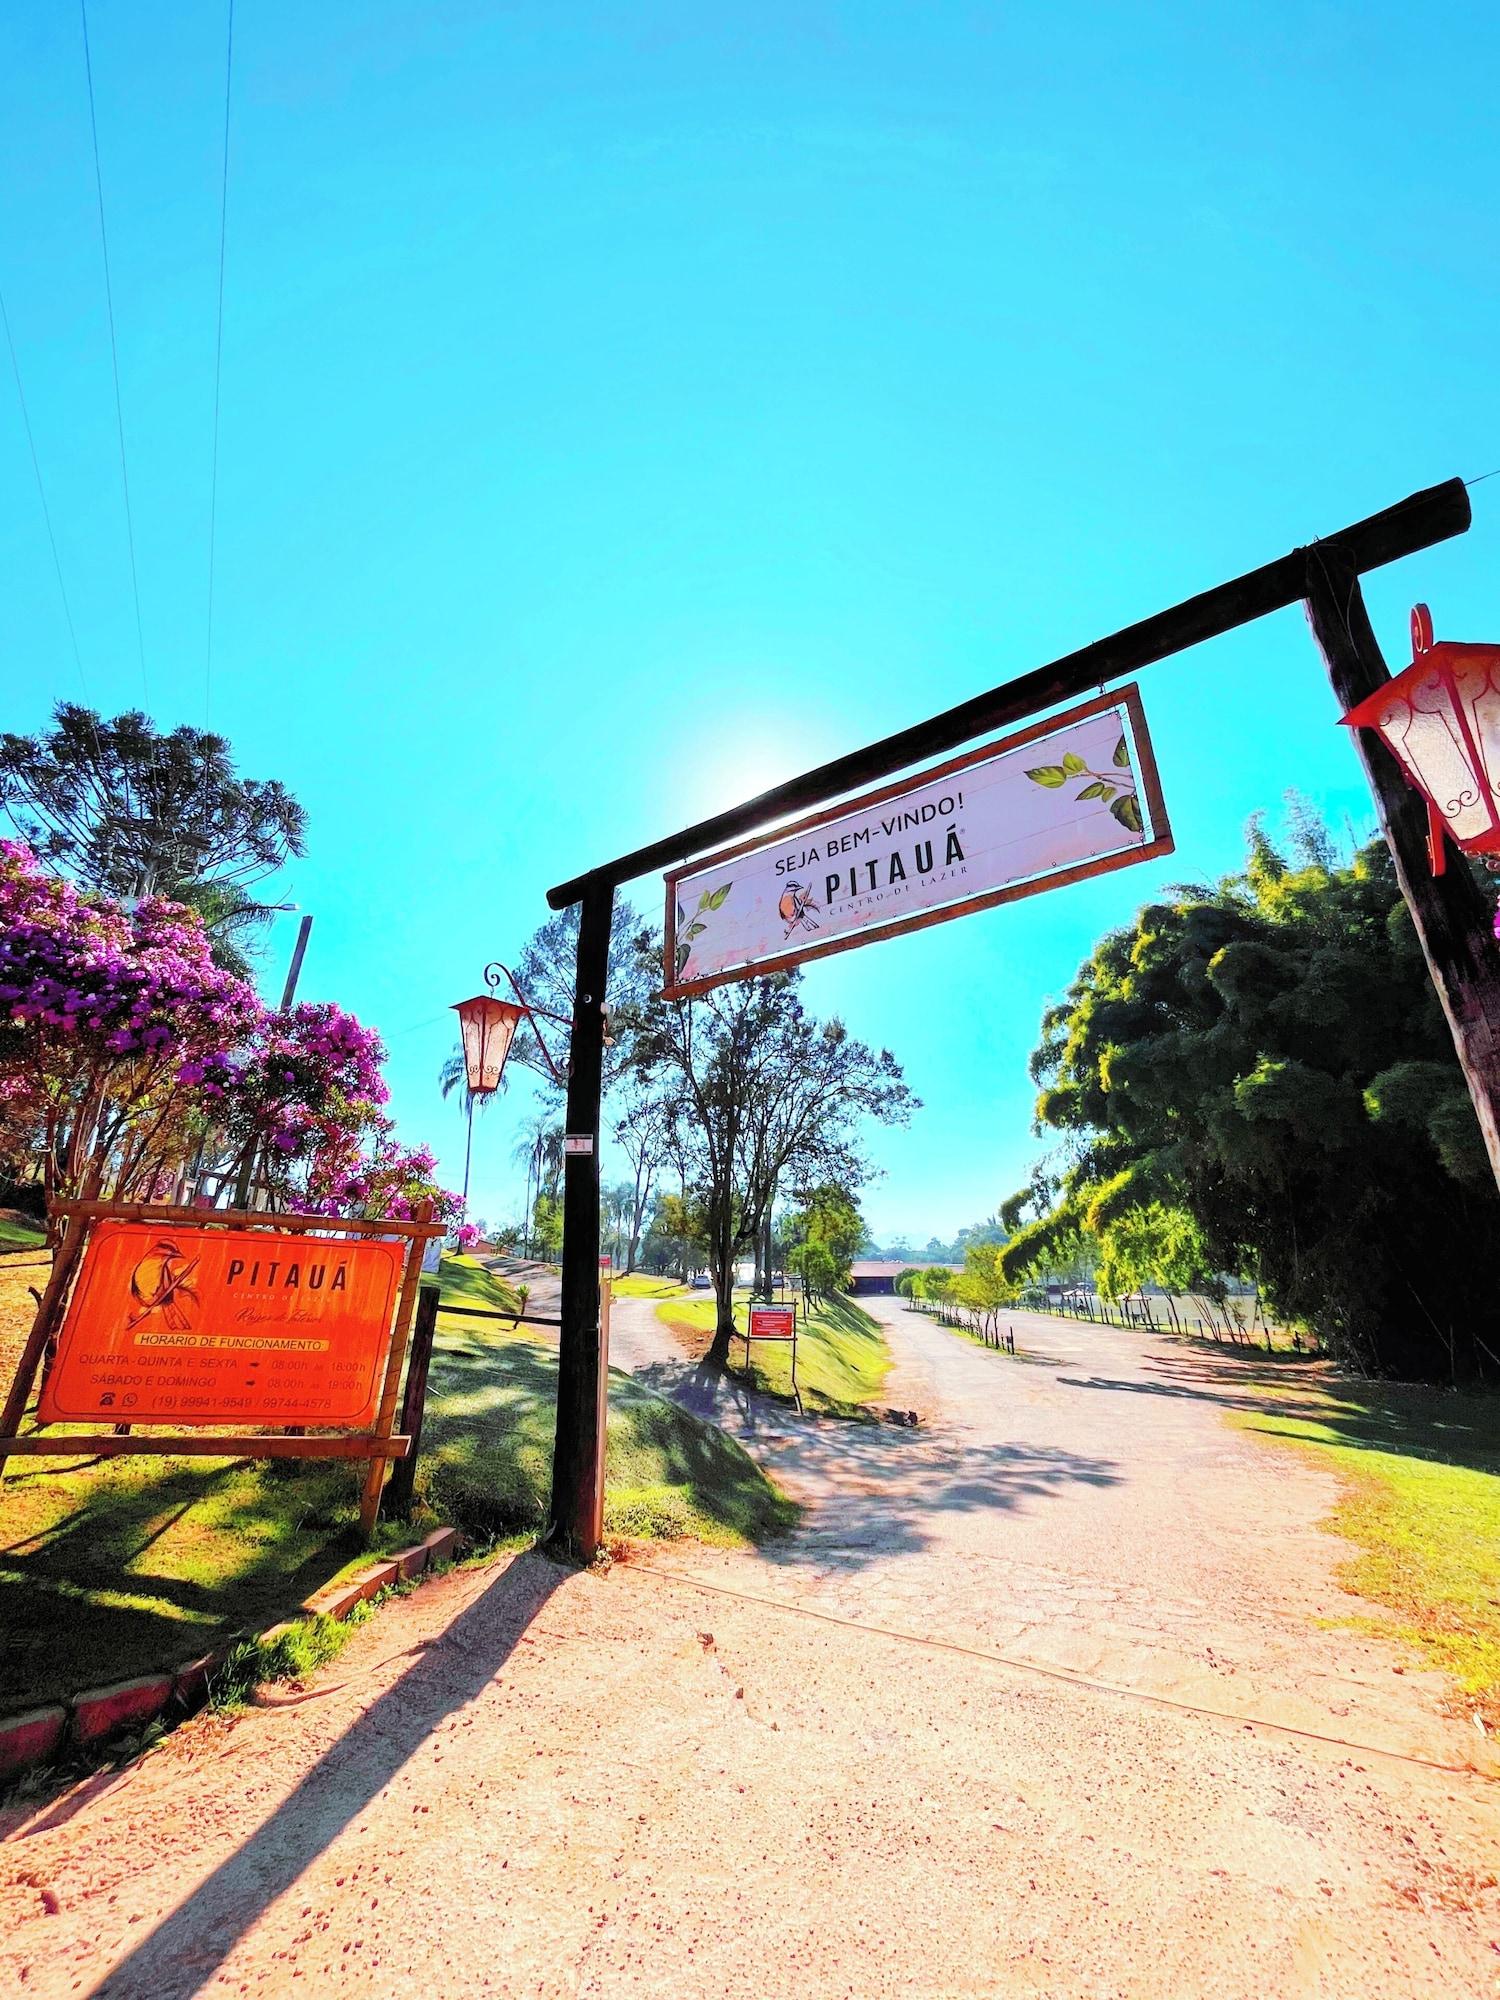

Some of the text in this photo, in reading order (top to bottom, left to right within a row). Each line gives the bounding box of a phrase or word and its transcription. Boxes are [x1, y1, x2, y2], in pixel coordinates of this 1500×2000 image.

[775, 792, 964, 876] SEJA BEM-VINDO!
[826, 823, 965, 904] PITAUÁ
[829, 866, 967, 916] CENTRO DE LAZER
[227, 1260, 347, 1290] PITAUÁ
[200, 1337, 217, 1347] DE
[79, 1354, 129, 1365] QUARTA
[137, 1355, 182, 1367] QUINTA
[187, 1358, 195, 1367] E
[199, 1358, 237, 1369] SEXTA
[145, 1375, 154, 1386] E
[157, 1375, 217, 1387] DOMINGO
[152, 1395, 177, 1409] (19)
